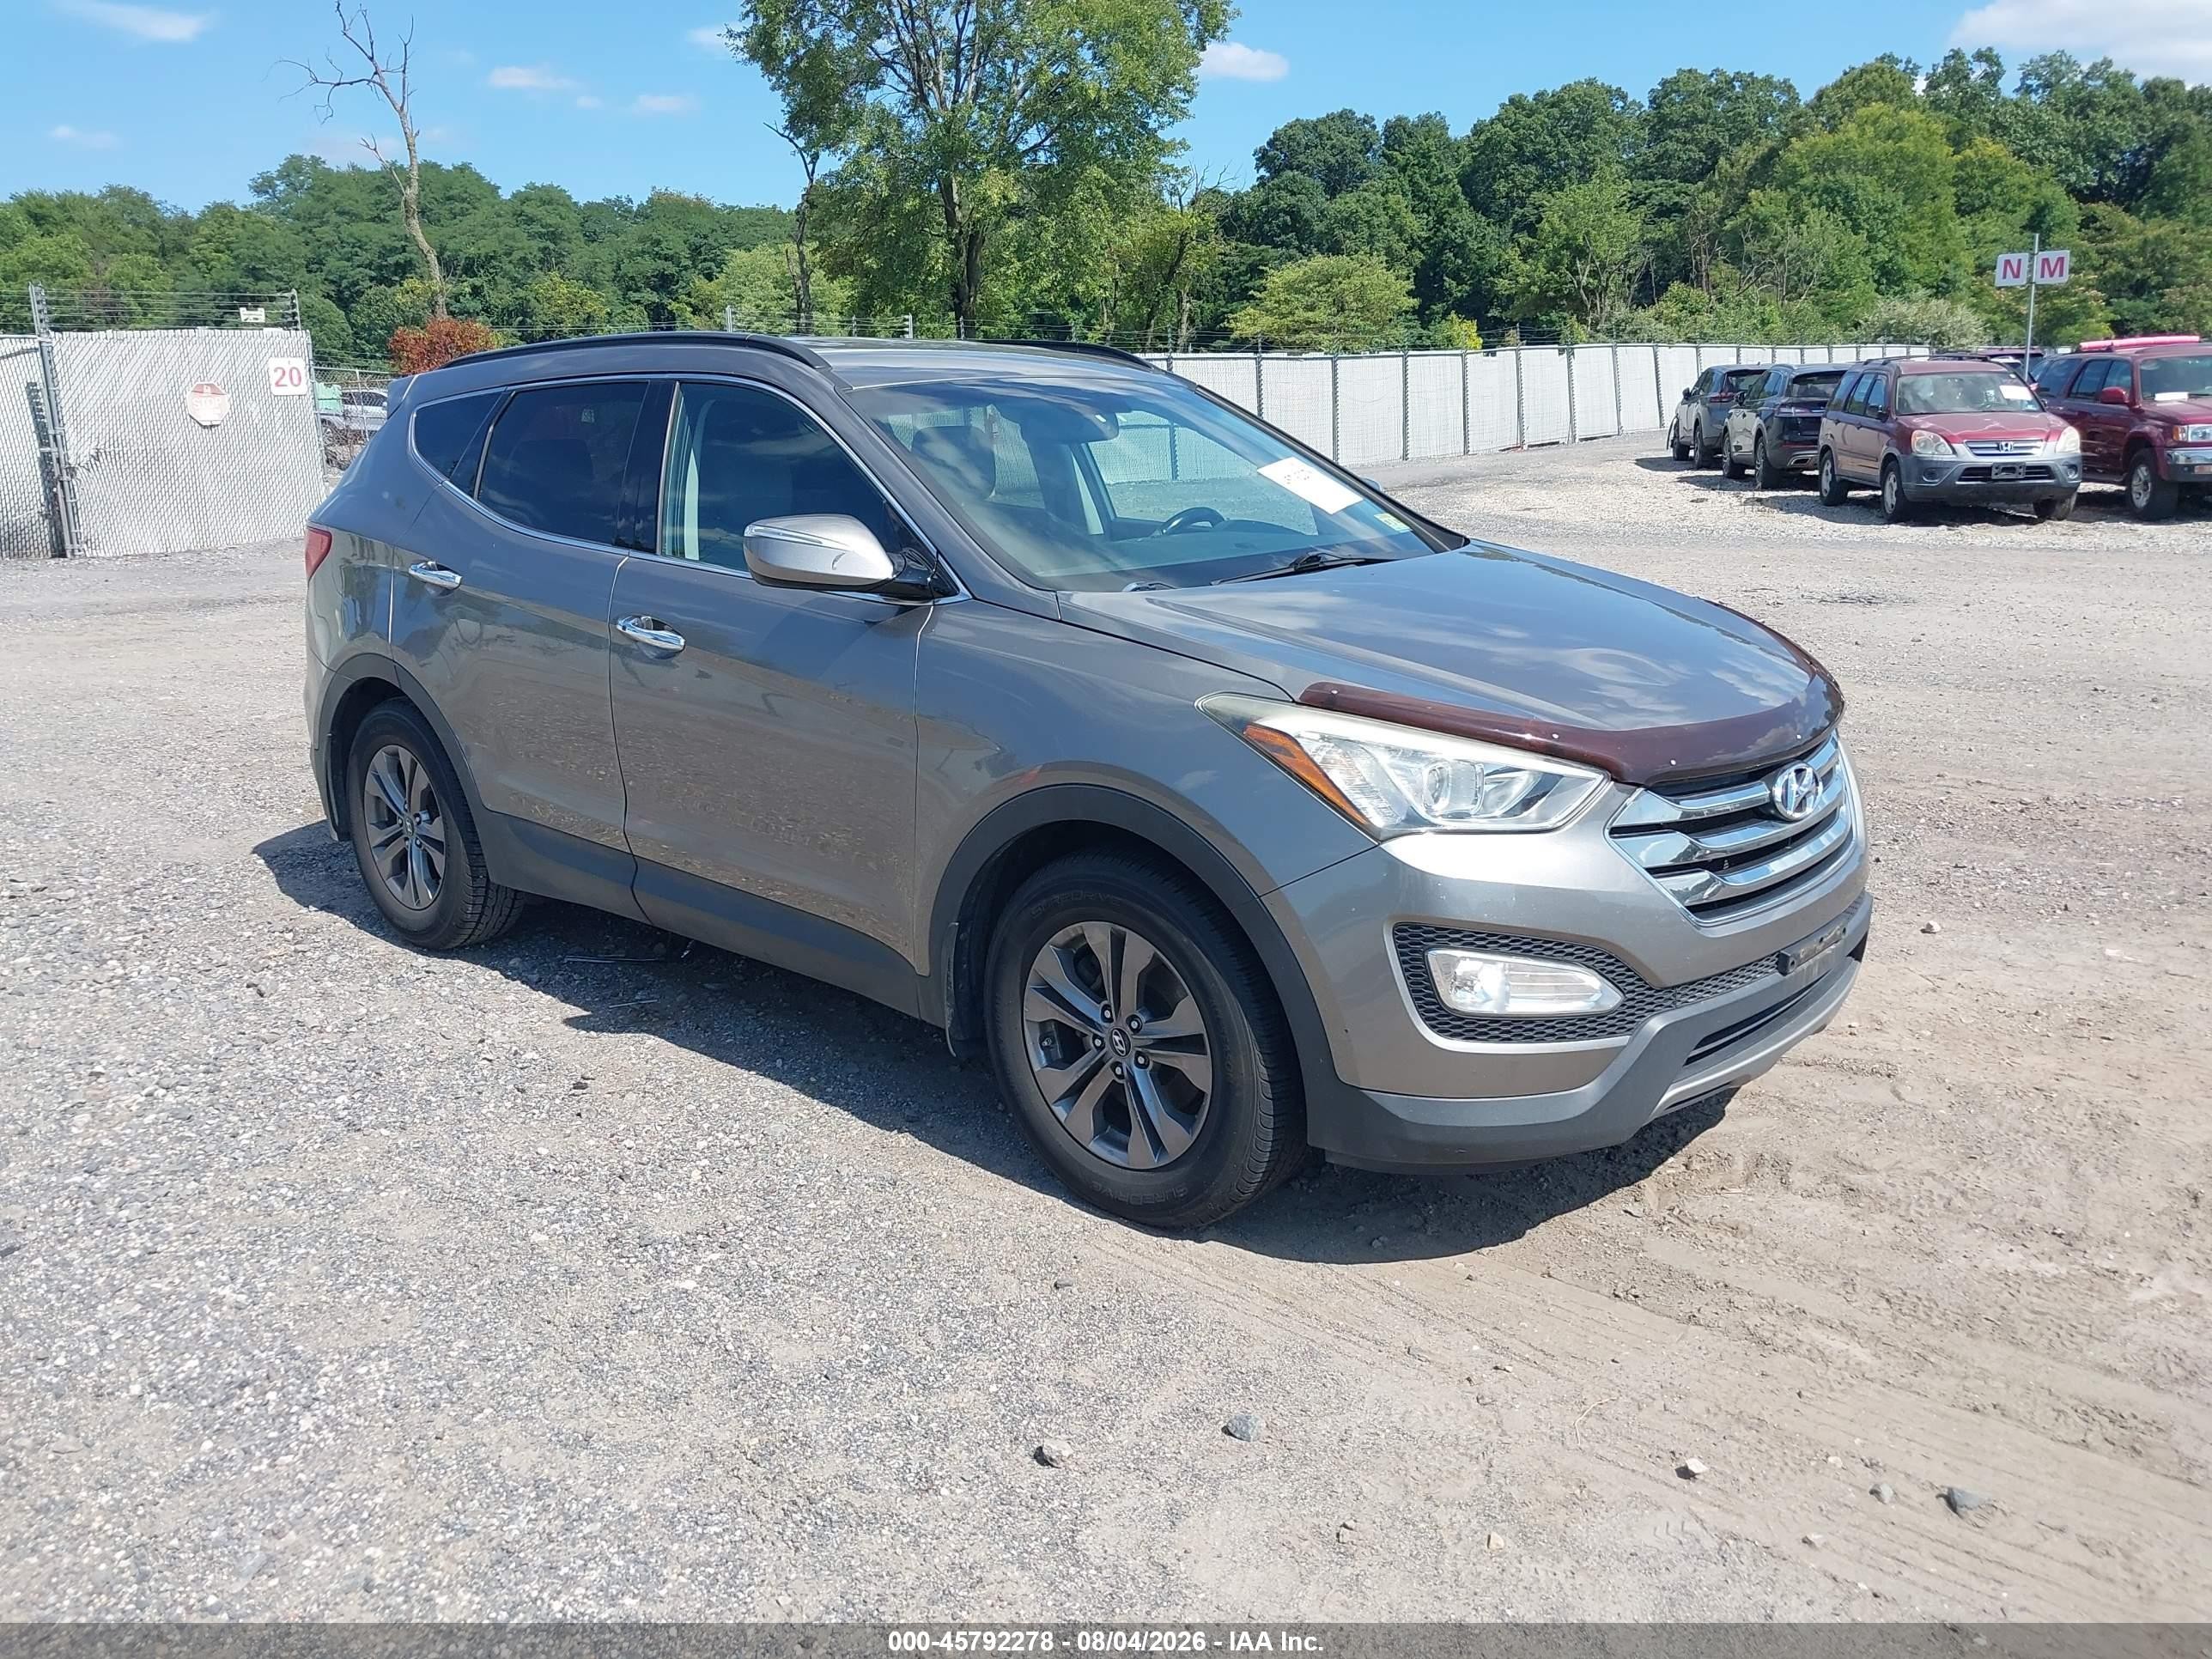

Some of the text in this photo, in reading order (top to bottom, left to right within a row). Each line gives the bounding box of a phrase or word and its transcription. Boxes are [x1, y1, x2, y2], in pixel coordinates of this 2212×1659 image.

[2002, 258, 2022, 279] N
[2039, 257, 2064, 278] M
[273, 367, 302, 387] 20
[191, 397, 221, 409] STOP
